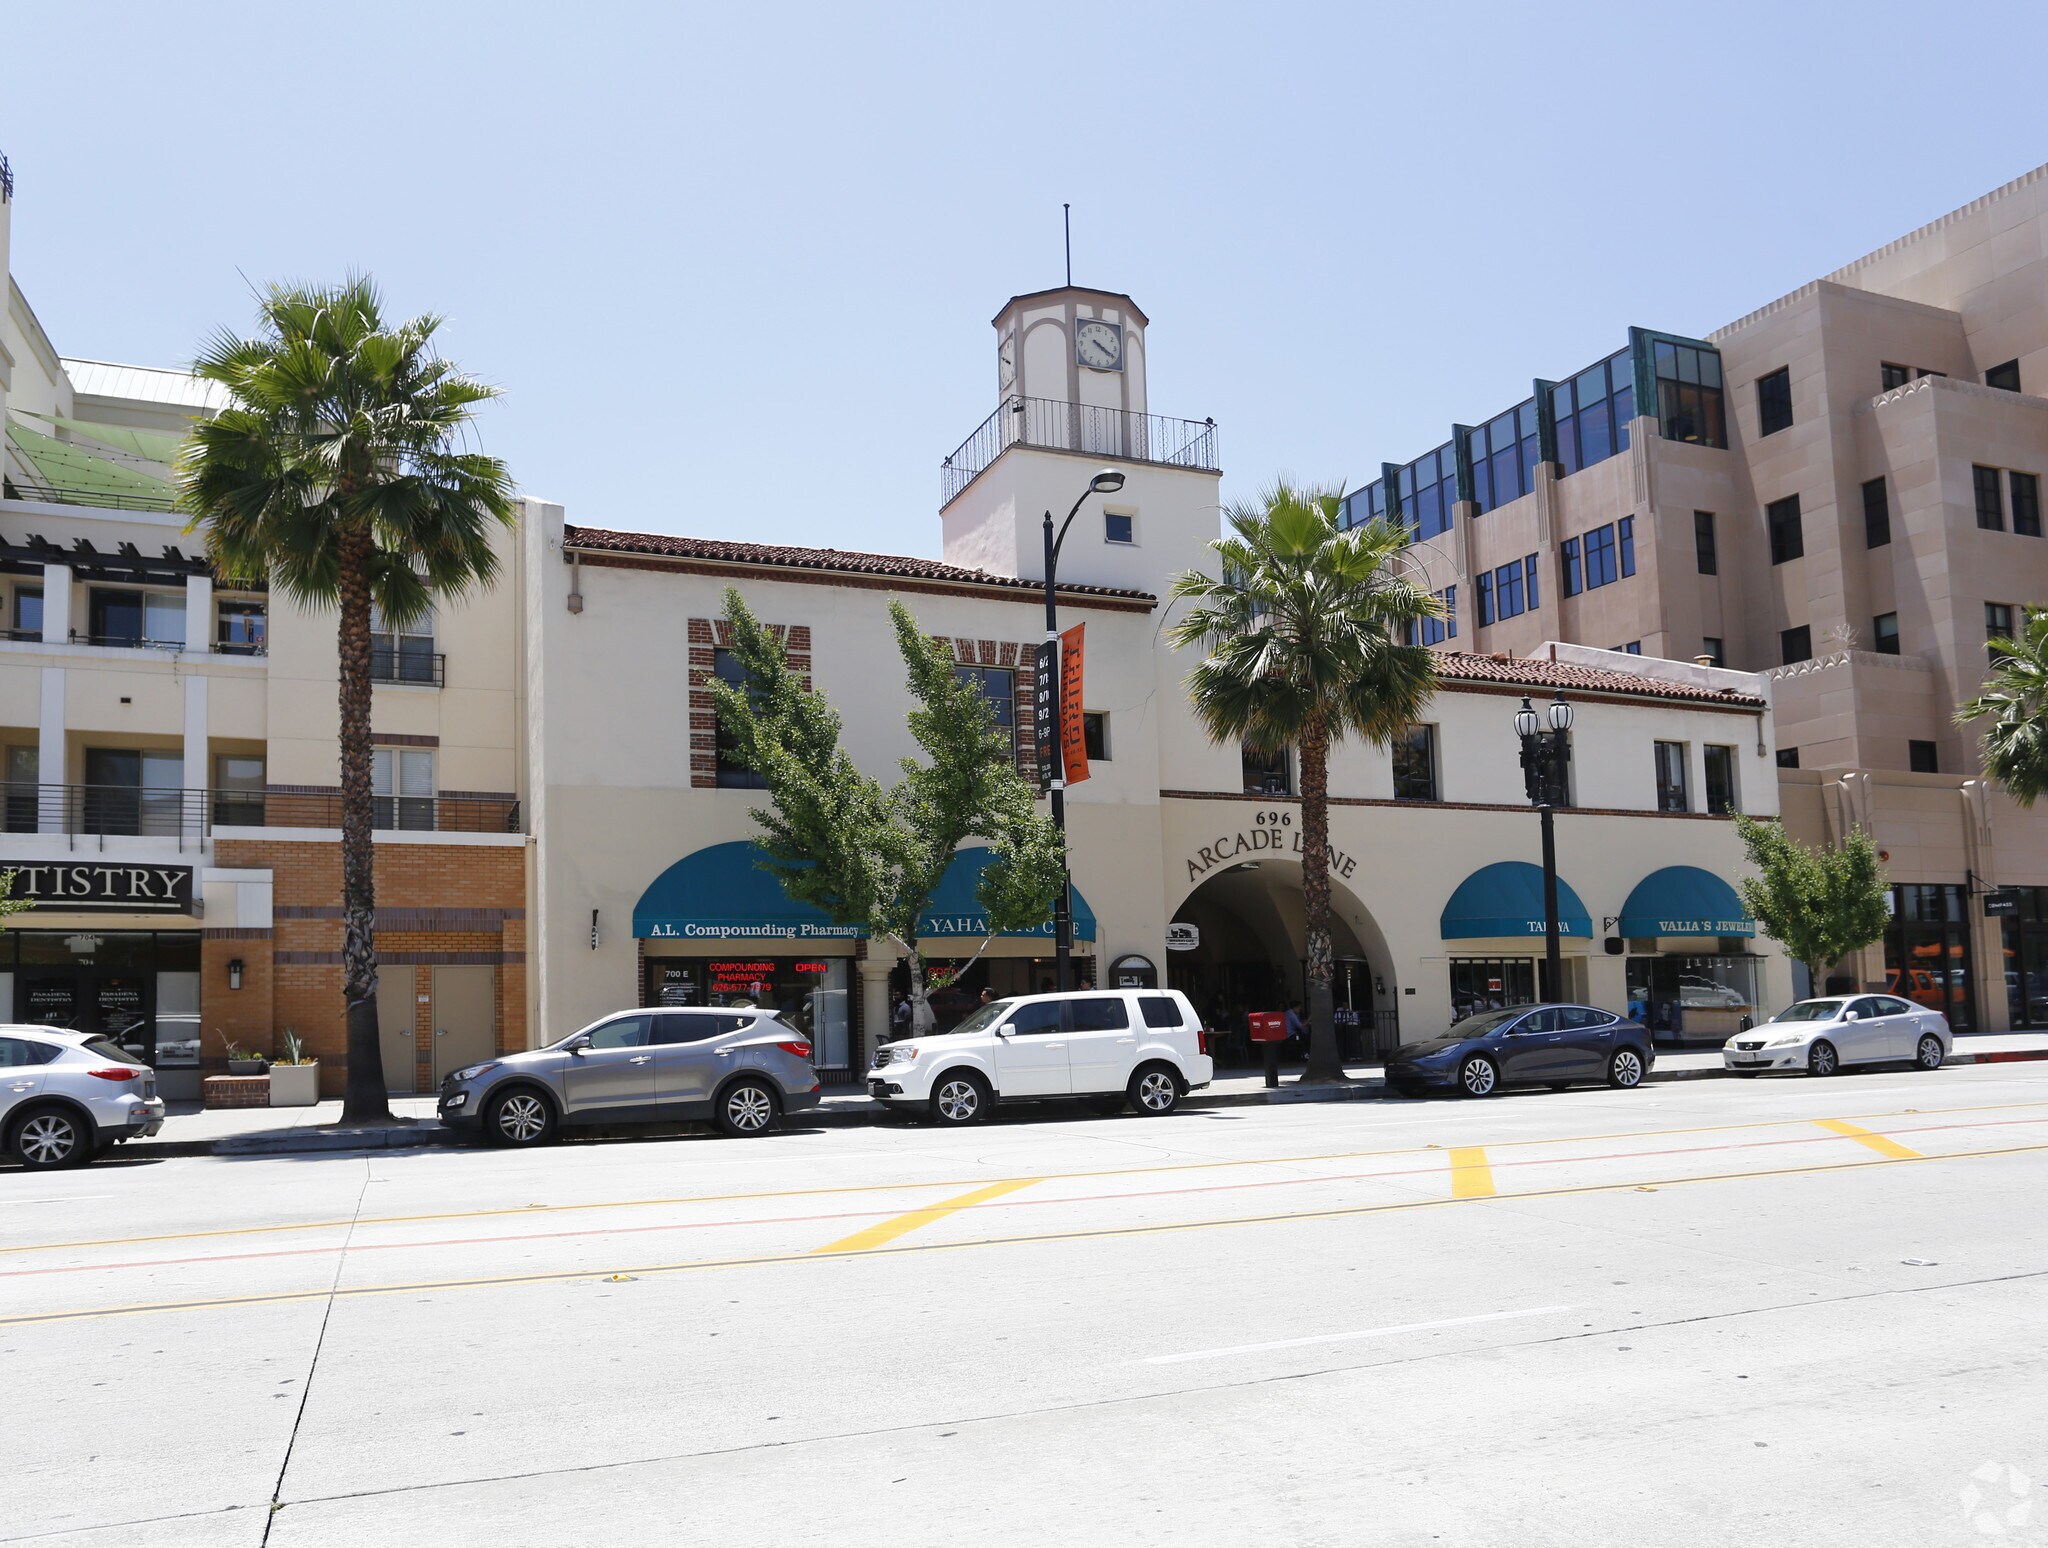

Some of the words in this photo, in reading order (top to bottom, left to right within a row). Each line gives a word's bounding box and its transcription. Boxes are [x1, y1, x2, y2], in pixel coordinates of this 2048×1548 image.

[1040, 656, 1048, 669] 6/2
[1039, 672, 1049, 686] 7/1
[1039, 690, 1049, 703] 8/1
[1038, 708, 1049, 720] 9/2
[1038, 726, 1050, 739] 6-9P
[1040, 744, 1051, 757] FRE
[1256, 812, 1291, 826] 696
[1187, 828, 1283, 882] ARCADE
[1292, 831, 1357, 879] LNE
[651, 924, 680, 936] A.L.
[684, 924, 796, 939] Compounding
[800, 924, 859, 938] Pharmacy
[1042, 920, 1080, 935] CE
[1527, 921, 1570, 932] TAYA
[709, 963, 775, 971] COMPOUNDING
[796, 963, 826, 972] OPEN
